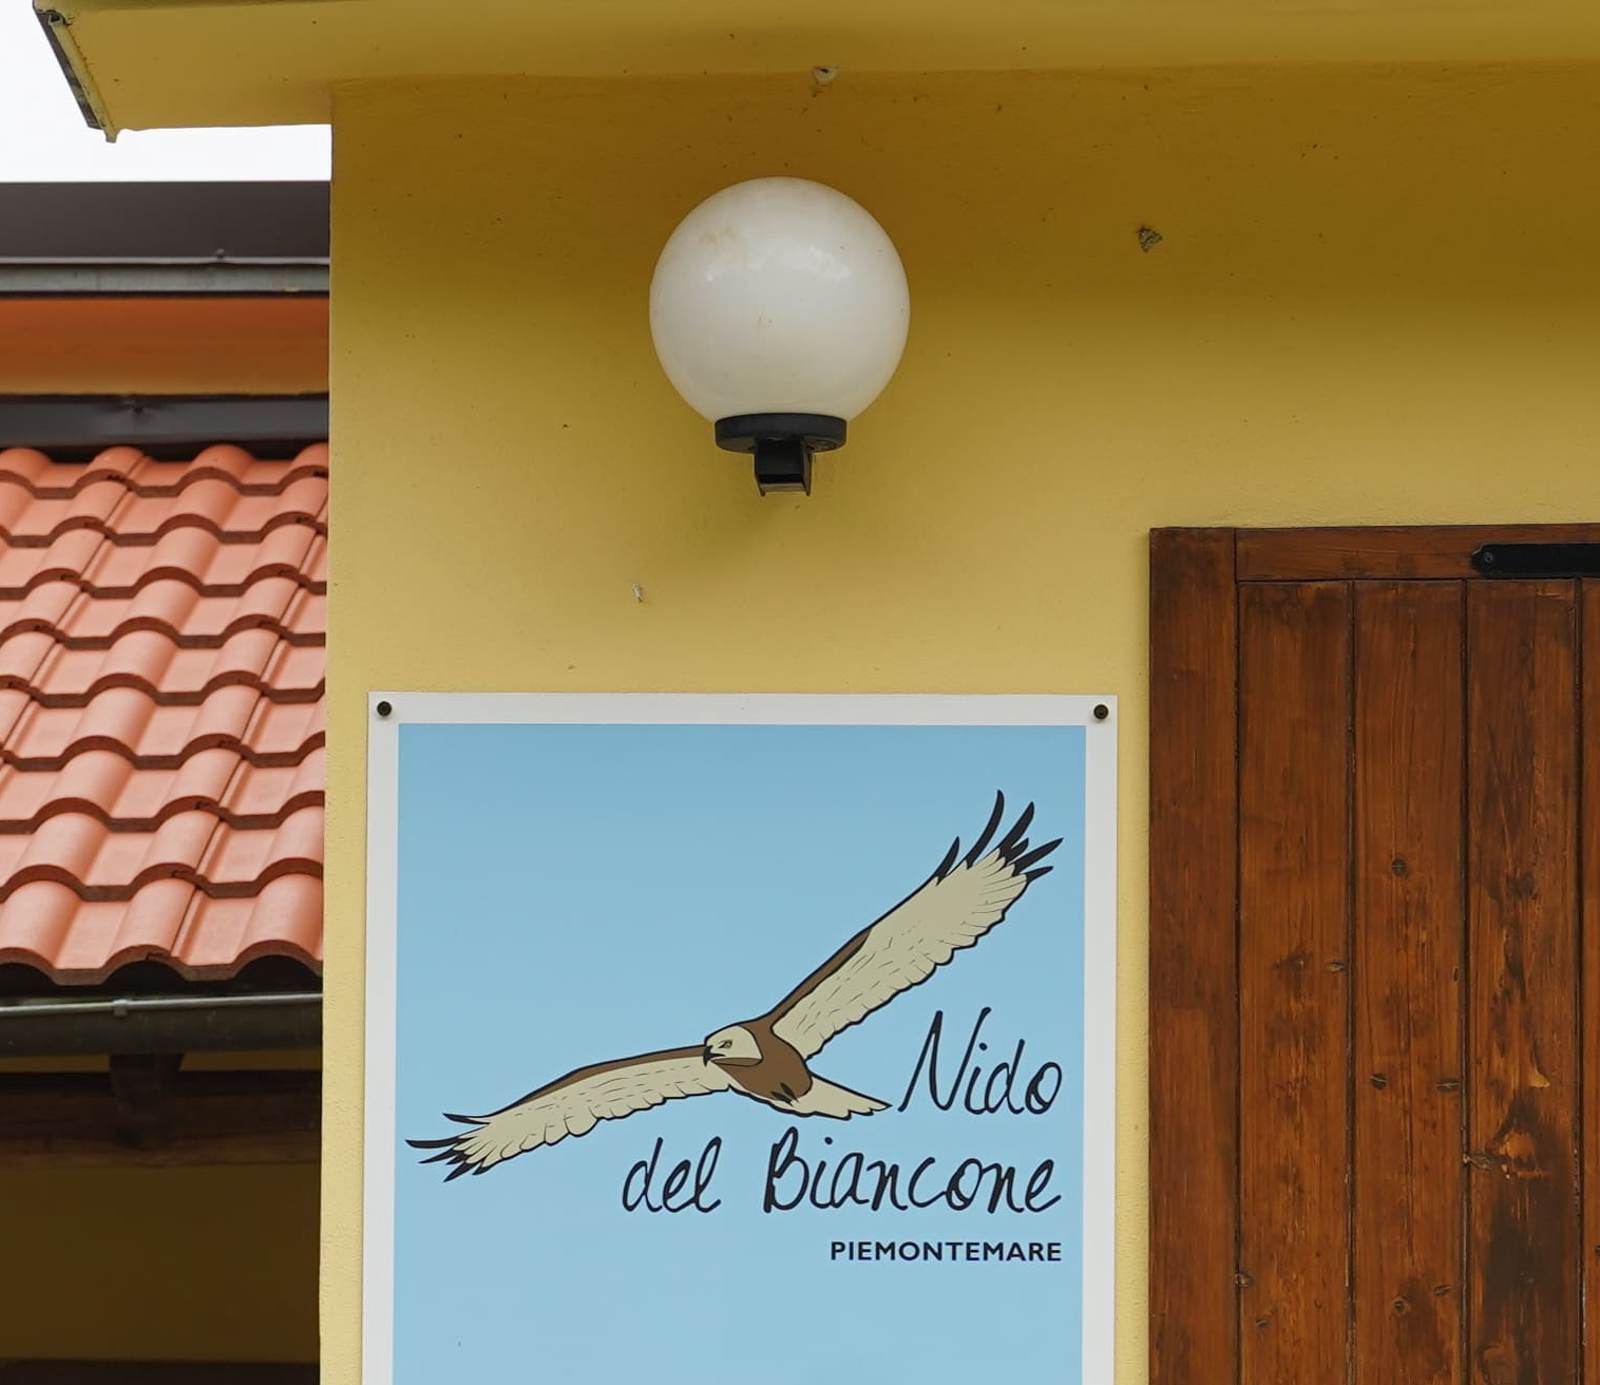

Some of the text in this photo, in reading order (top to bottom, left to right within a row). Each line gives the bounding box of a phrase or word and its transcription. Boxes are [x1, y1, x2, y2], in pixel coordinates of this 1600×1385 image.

[898, 1007, 1062, 1115] Nido
[622, 1127, 1062, 1214] del Biancone
[830, 1241, 1062, 1262] PIEMONTEMARE
